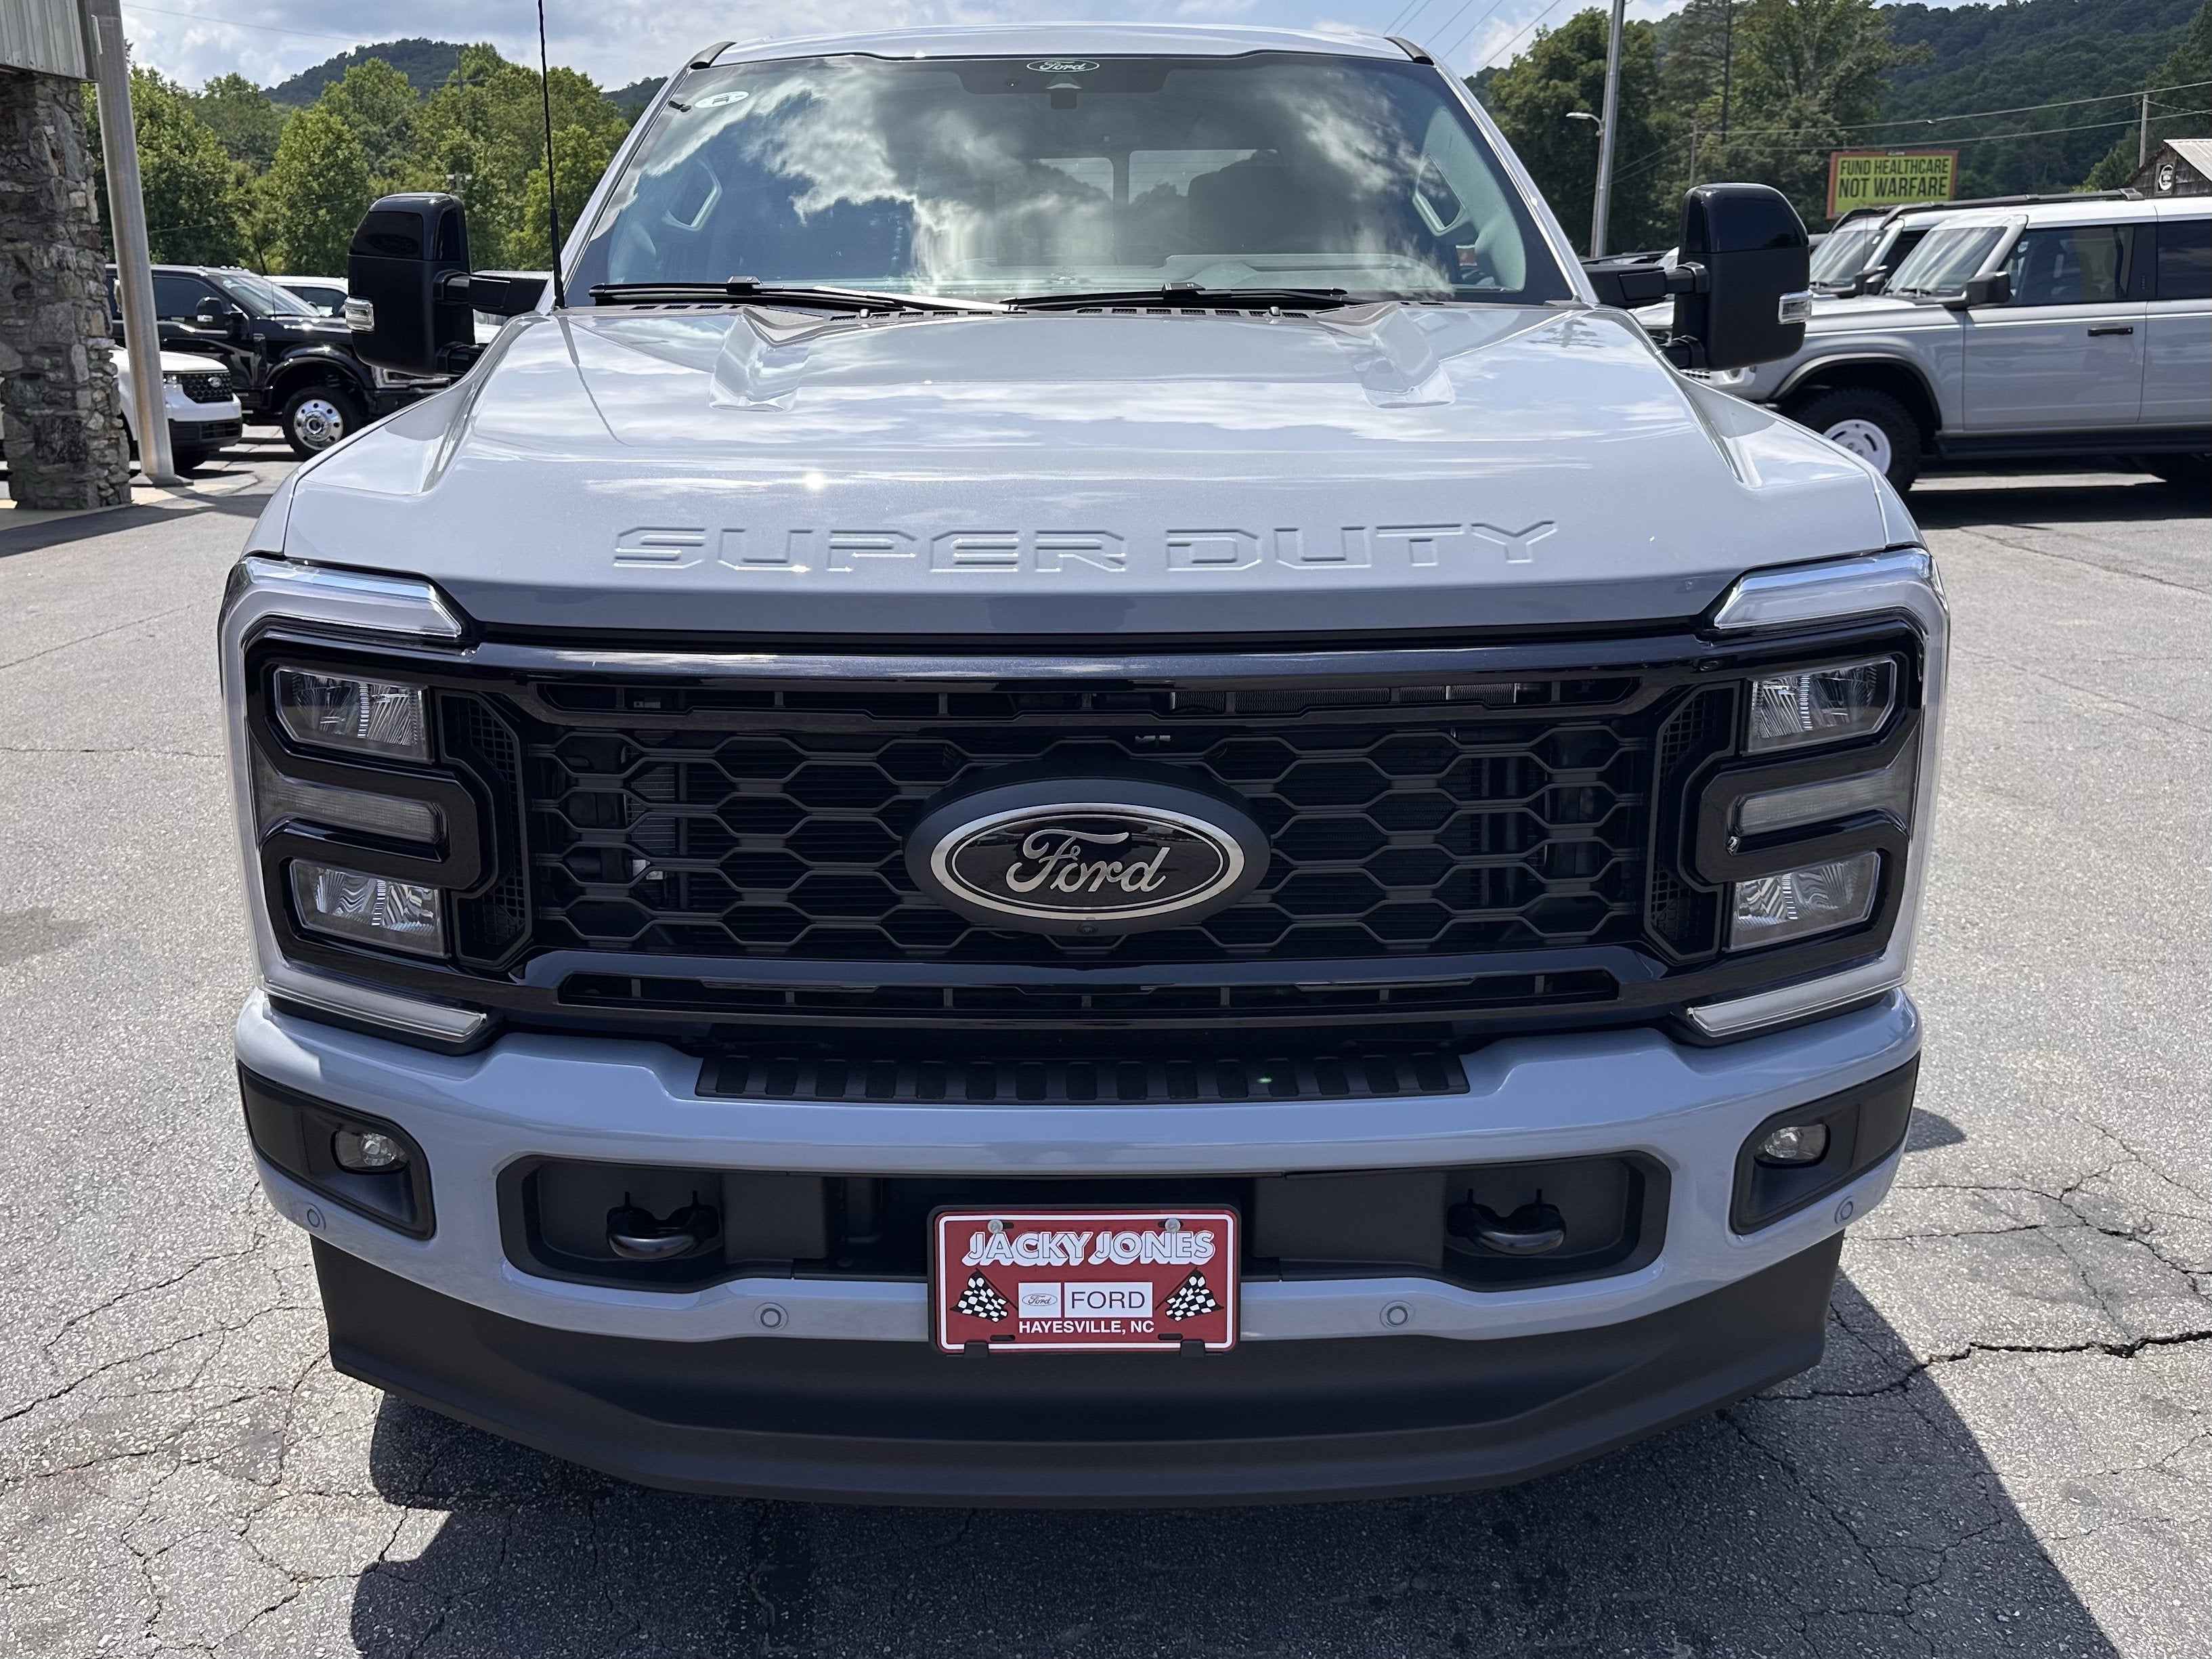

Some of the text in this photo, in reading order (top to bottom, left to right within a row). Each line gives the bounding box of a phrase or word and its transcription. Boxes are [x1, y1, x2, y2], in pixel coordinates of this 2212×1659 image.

[1039, 60, 1087, 70] Ford
[1840, 158, 1949, 175] FUND HEALTHCARE
[1838, 177, 1948, 198] NOT WARFARE
[613, 520, 1558, 572] SUPER DUTY
[1005, 829, 1171, 893] Ford
[961, 1230, 1215, 1266] JACKY JONES
[1028, 1294, 1051, 1305] Ford
[1071, 1291, 1146, 1310] FORD
[1018, 1320, 1154, 1334] HAYESVILLE, NC
